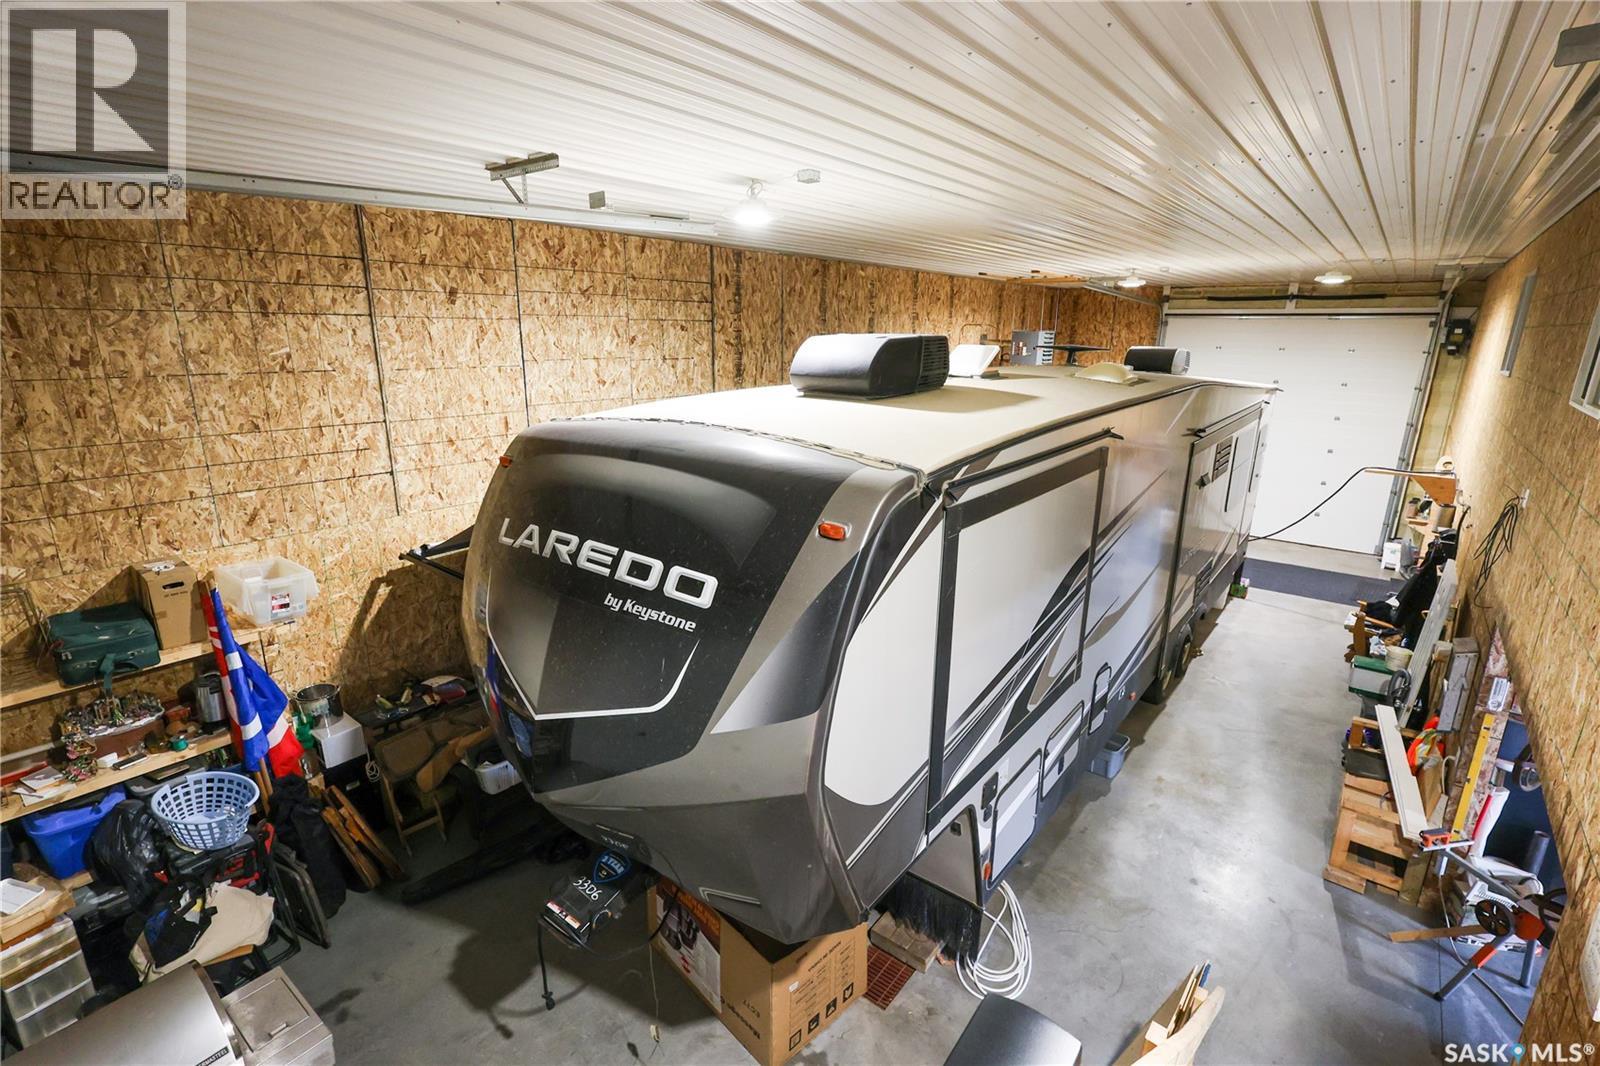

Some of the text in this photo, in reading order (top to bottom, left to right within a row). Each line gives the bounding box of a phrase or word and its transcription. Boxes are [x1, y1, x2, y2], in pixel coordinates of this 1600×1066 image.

[497, 517, 719, 610] LAREDO
[603, 592, 697, 632] by Keystone
[572, 876, 603, 901] 3306
